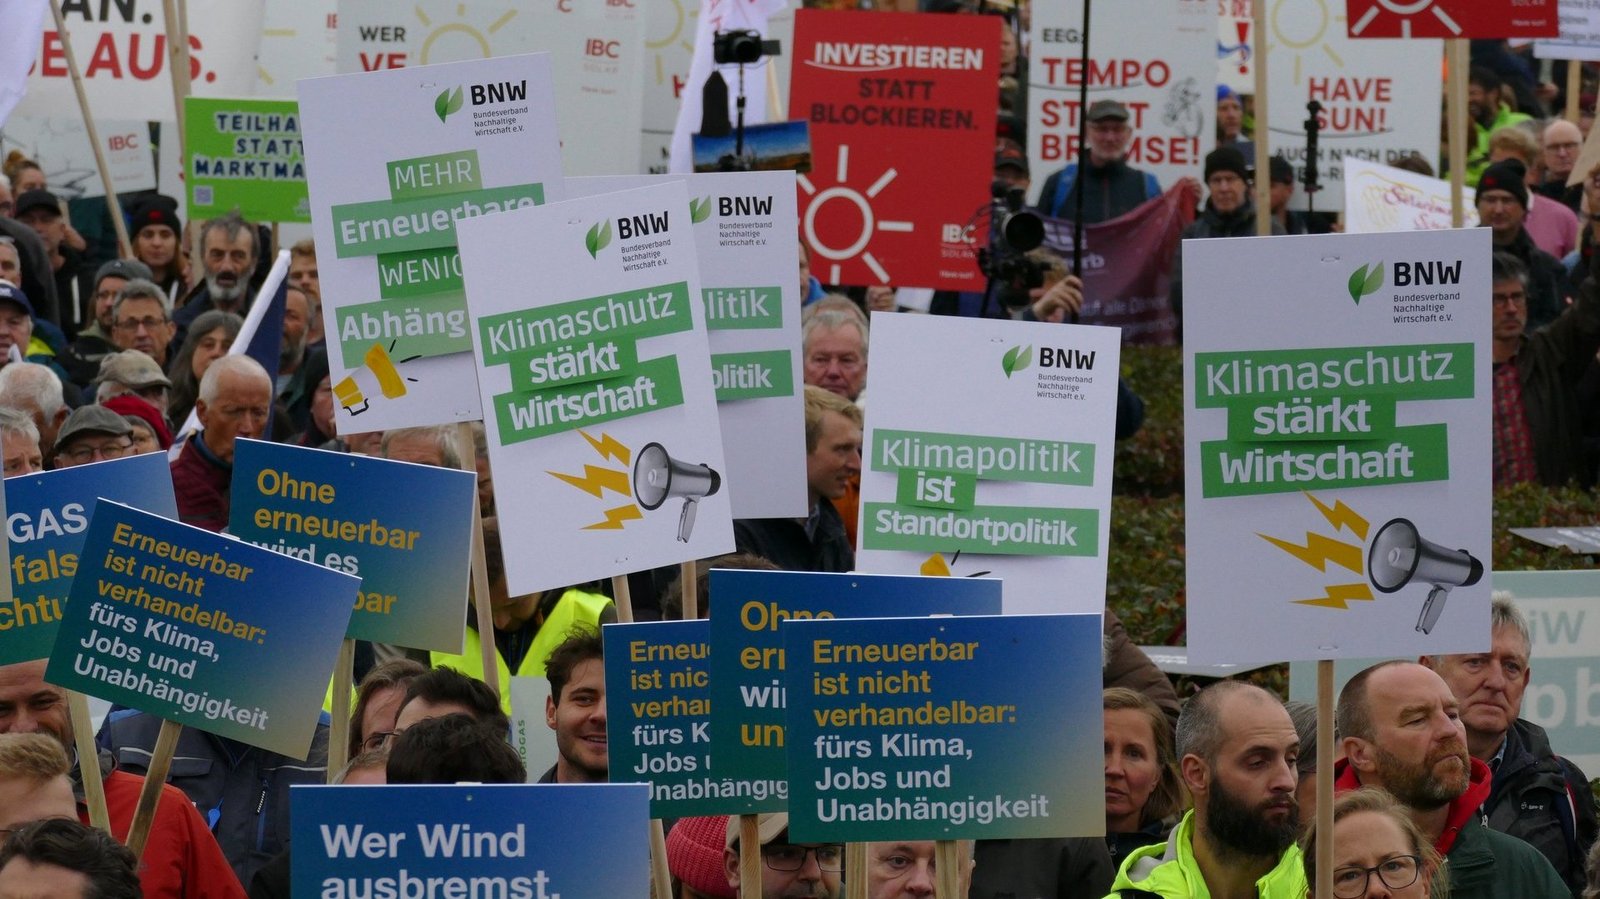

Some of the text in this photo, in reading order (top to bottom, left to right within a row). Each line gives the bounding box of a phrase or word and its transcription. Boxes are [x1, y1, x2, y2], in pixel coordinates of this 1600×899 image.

[359, 26, 406, 41] WER
[586, 39, 620, 58] IBC
[815, 42, 983, 70] INVESTIEREN
[1041, 58, 1171, 88] TEMPO
[470, 80, 527, 106] BNW
[859, 78, 936, 98] STATT
[1308, 77, 1392, 101] HAVE
[473, 106, 529, 119] Bundesverband
[474, 117, 517, 128] Nachhaltige
[810, 103, 979, 131] BLOCKIEREN.
[1315, 107, 1386, 132] SUN!
[108, 134, 138, 151] IBC
[475, 125, 525, 136] Wirtschaft e.V.
[394, 158, 473, 190] MEHR
[719, 196, 773, 217] BNW
[618, 210, 669, 240] BNW
[719, 222, 773, 230] Bundesverband
[719, 231, 761, 239] Nachhaltige
[621, 238, 671, 254] Bundesverband
[622, 250, 661, 263] Nachhaltige
[720, 239, 754, 247] Wirtschaft
[623, 261, 657, 272] Wirtschaft
[1393, 260, 1462, 287] BNW
[708, 289, 770, 320] litik
[1393, 292, 1460, 302] Bundesverband
[1393, 303, 1445, 313] Nachhaltige
[341, 307, 466, 342] Abhäng
[488, 291, 677, 355] Klimaschutz
[1393, 313, 1453, 323] Wirtschaft e.V.
[529, 341, 620, 384] stärkt
[1039, 347, 1096, 371] BNW
[1038, 373, 1093, 384] Bundesverband
[1206, 350, 1454, 396] Klimaschutz
[1037, 382, 1080, 392] Nachhaltige
[1037, 391, 1072, 400] Wirtschaft
[509, 376, 658, 432] Wirtschaft
[1253, 397, 1371, 435] stärkt
[882, 438, 1081, 475] Klimapolitik
[1219, 442, 1414, 484] Wirtschaft
[257, 468, 336, 504] Ohne
[916, 471, 957, 503] ist
[6, 503, 88, 543] GAS
[254, 507, 420, 550] erneuerbar
[875, 509, 1078, 546] Standortpolitik
[112, 522, 253, 582] Erneuerbar
[324, 551, 359, 575] es
[104, 549, 205, 597] ist nicht
[98, 580, 267, 644] verhandelbar:
[89, 602, 220, 662] fürs Klima,
[80, 629, 197, 679] Jobs und
[630, 641, 711, 662] Erneu
[813, 637, 979, 664] Erneuerbar
[73, 653, 269, 731] Unabhängigkeit
[631, 667, 709, 690] ist nic
[813, 670, 931, 695] ist nicht
[814, 700, 1016, 727] verhandelbar:
[632, 724, 684, 746] fürs
[814, 733, 973, 760] fürs Klima,
[634, 752, 697, 774] Jobs
[815, 764, 951, 790] Jobs und
[816, 793, 1049, 825] Unabhängigkeit
[320, 822, 526, 859] Wer Wind
[320, 869, 561, 899] ausbremst.
